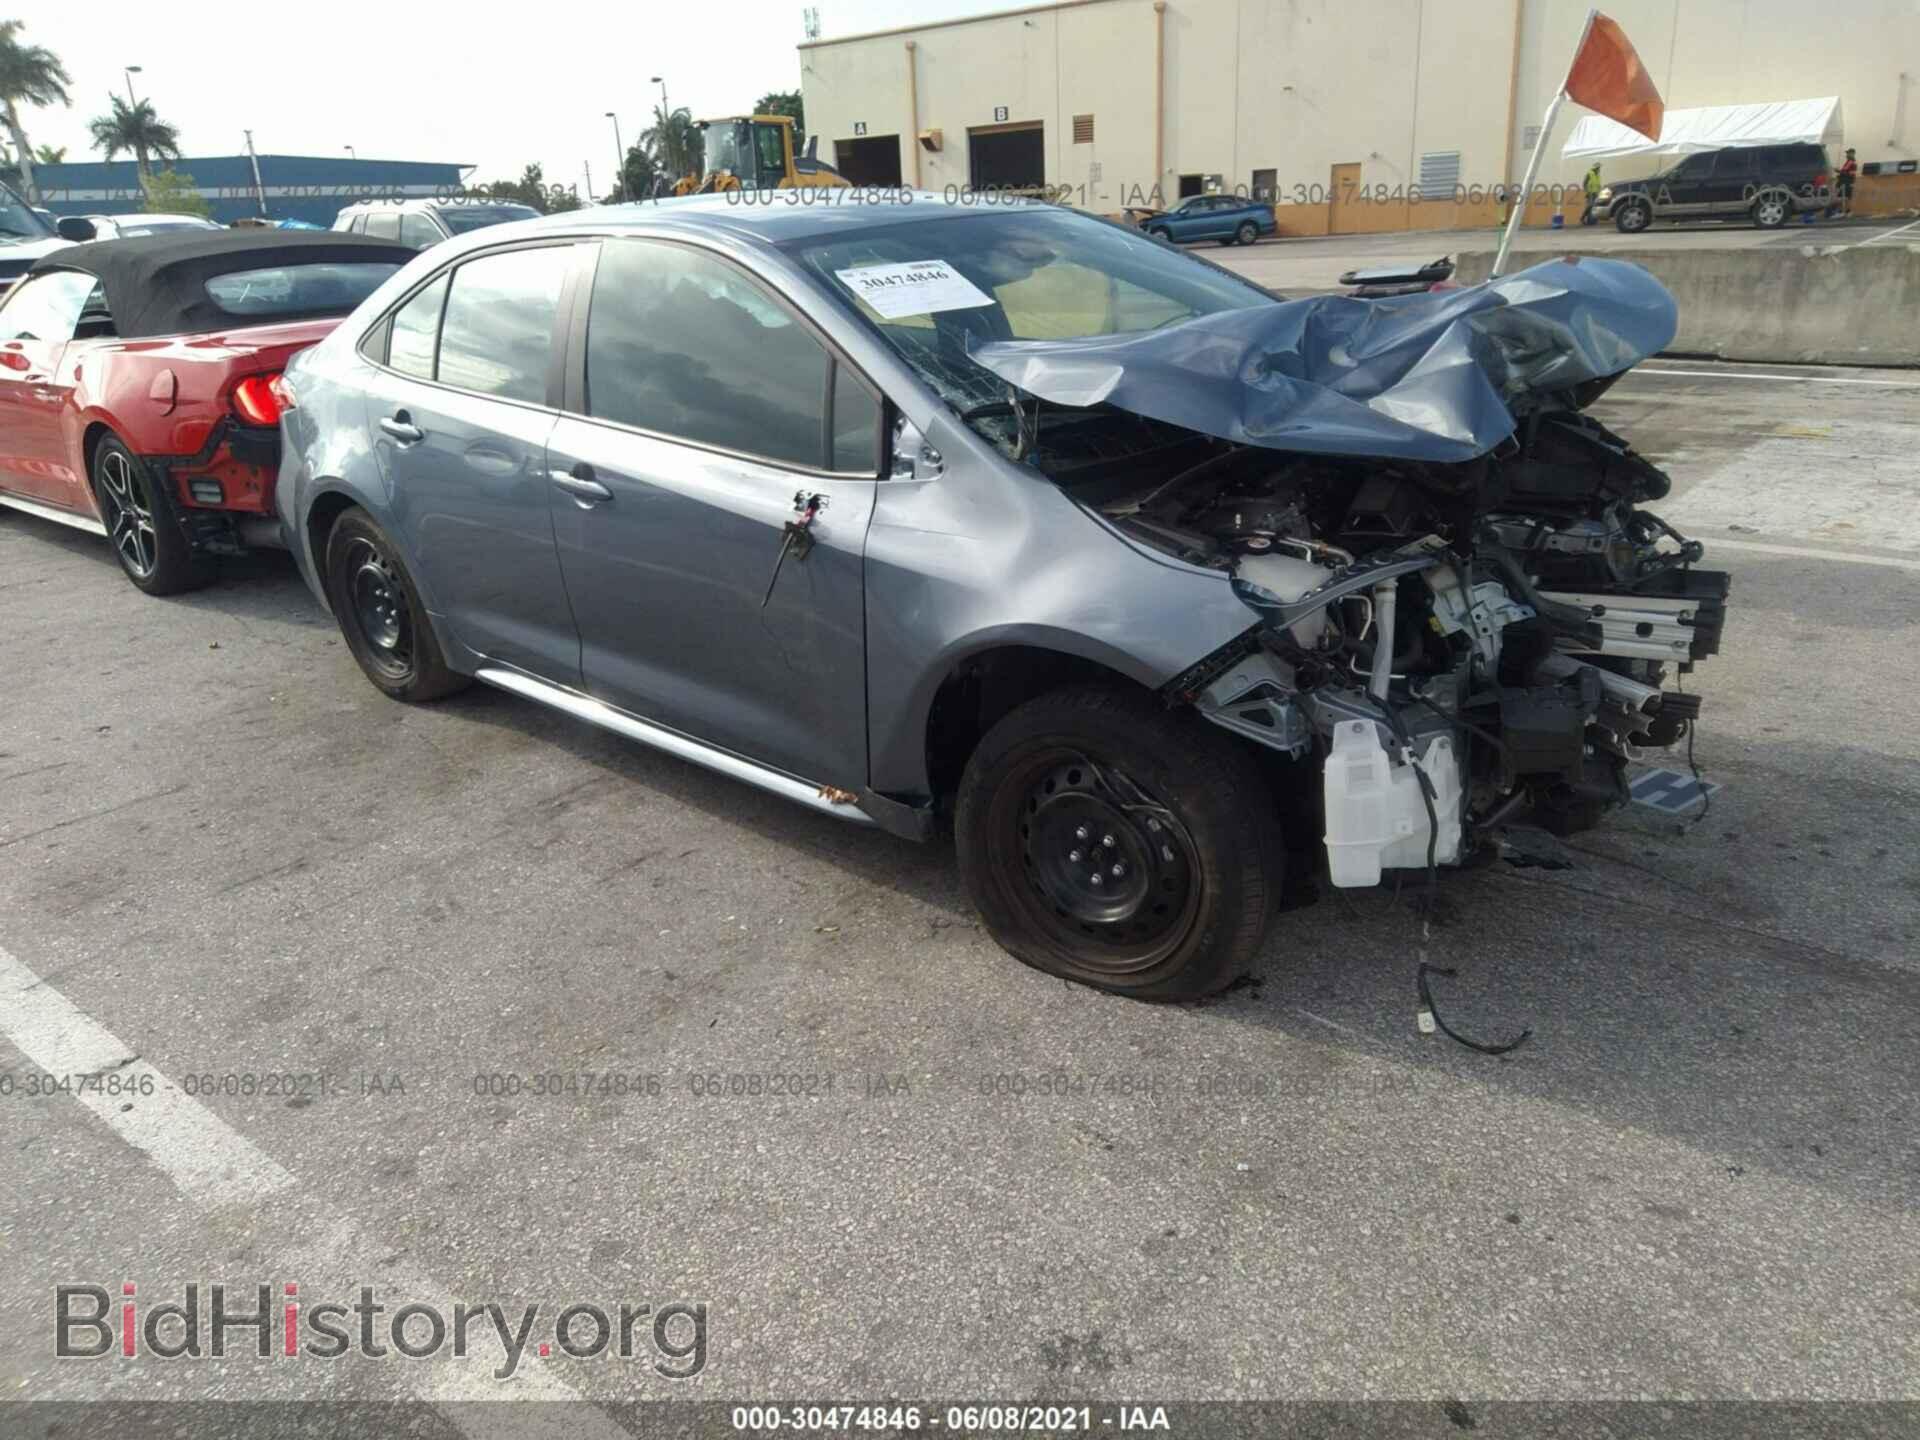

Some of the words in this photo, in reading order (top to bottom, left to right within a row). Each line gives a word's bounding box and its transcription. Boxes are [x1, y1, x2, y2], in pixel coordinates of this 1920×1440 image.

[996, 107, 1007, 121] B
[855, 123, 866, 135] A
[860, 270, 949, 289] 30474846
